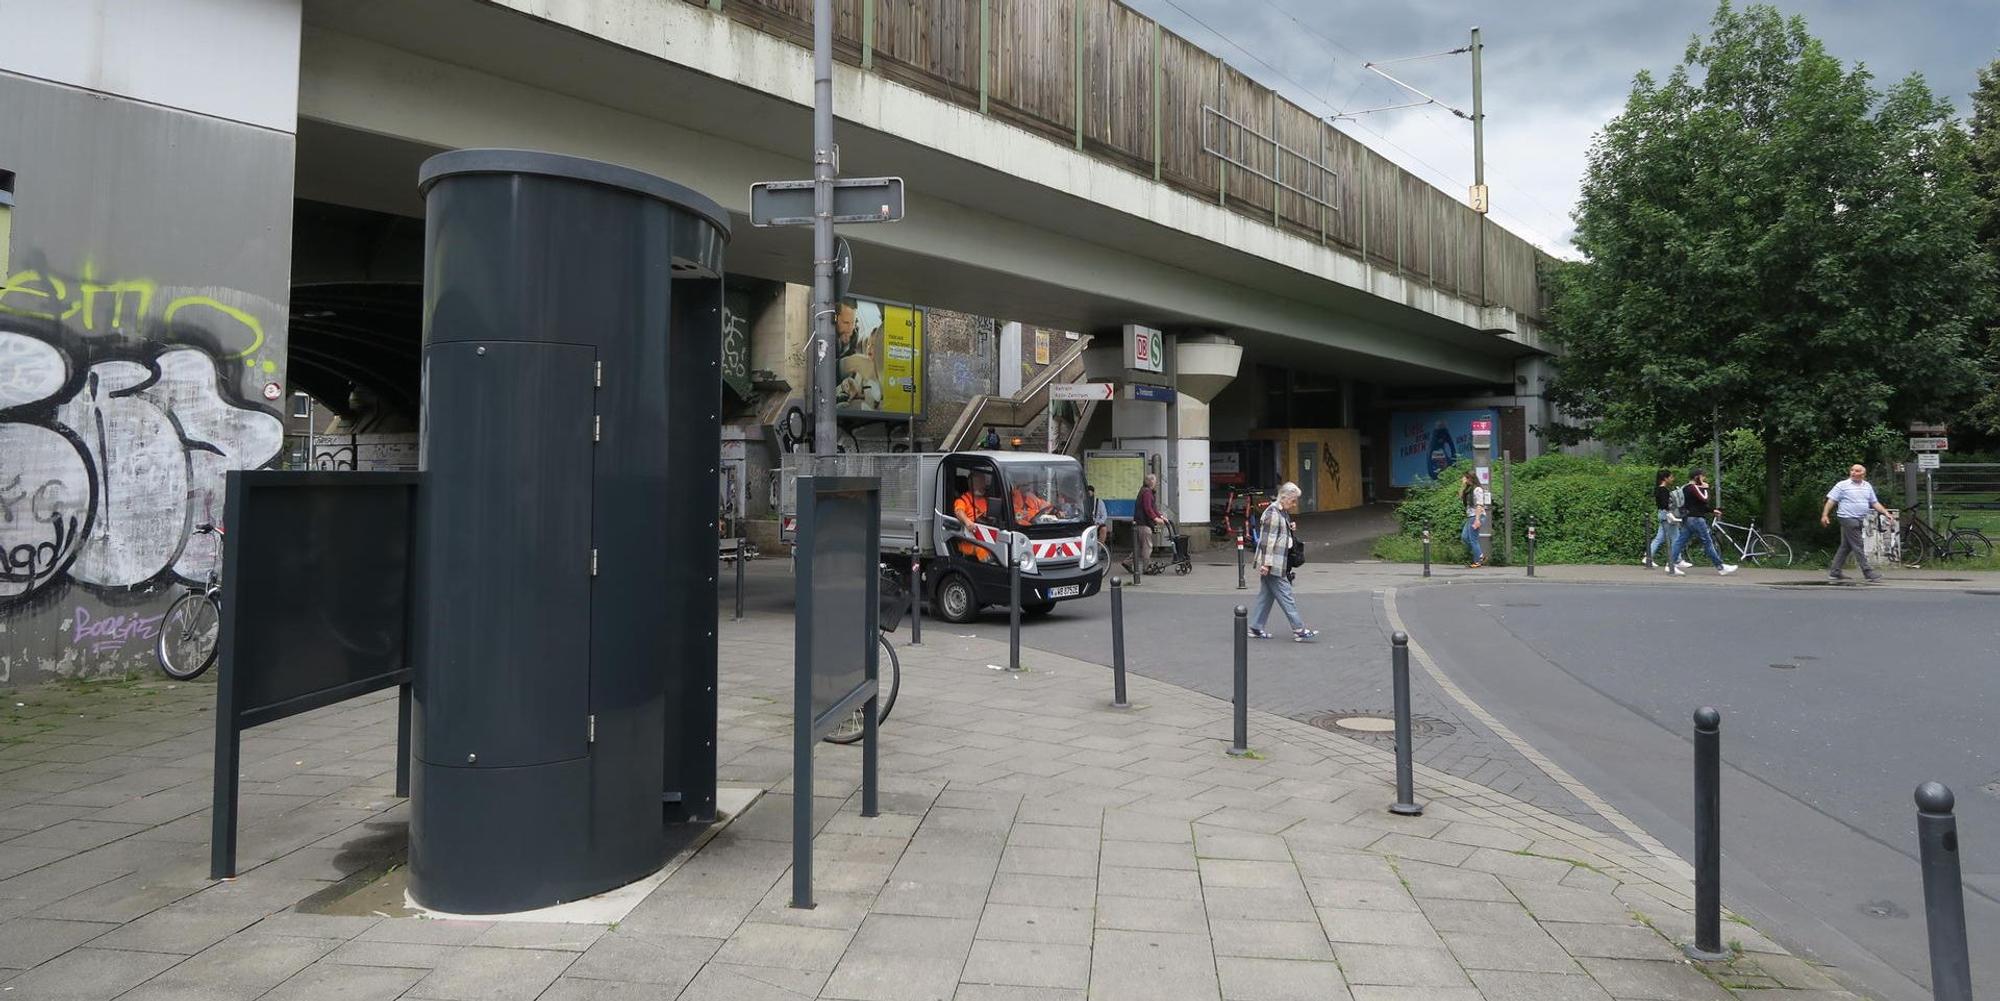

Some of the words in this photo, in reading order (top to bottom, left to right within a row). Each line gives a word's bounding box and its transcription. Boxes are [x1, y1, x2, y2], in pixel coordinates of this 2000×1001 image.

[1474, 198, 1482, 210] 2
[1136, 335, 1148, 359] DB
[1151, 337, 1161, 364] S
